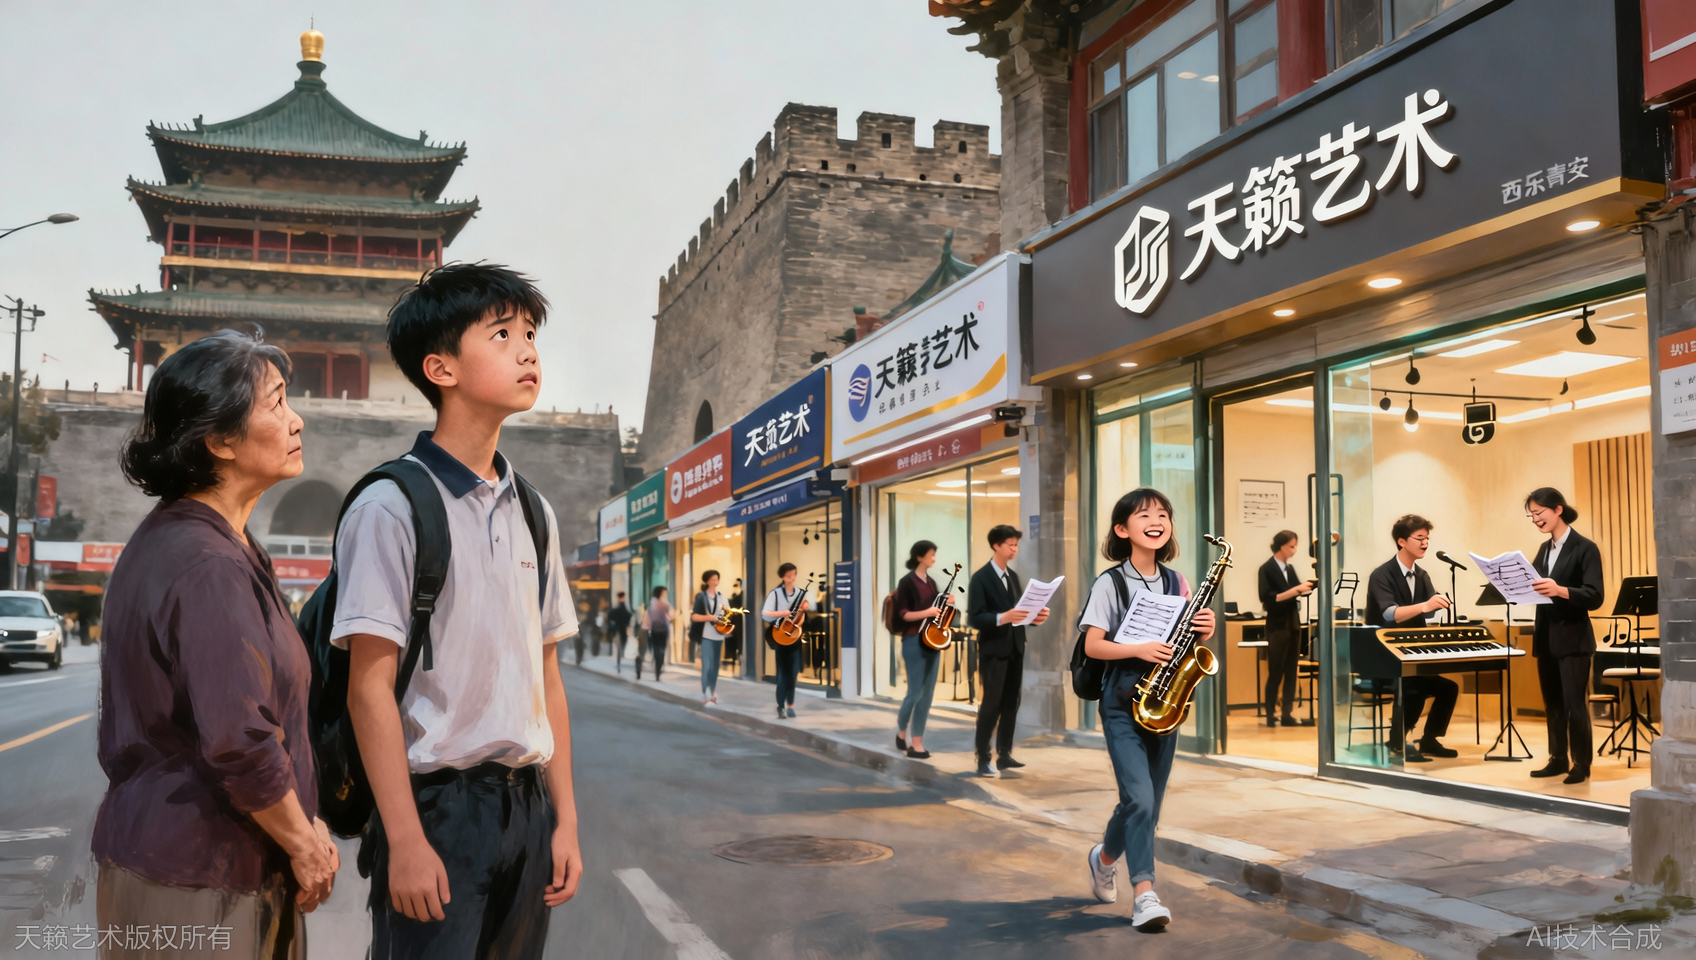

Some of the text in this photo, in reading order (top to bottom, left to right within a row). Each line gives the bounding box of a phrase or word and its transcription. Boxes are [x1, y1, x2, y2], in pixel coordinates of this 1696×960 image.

[1179, 88, 1458, 281] 天籁艺术
[1501, 156, 1589, 205] 西乐青安
